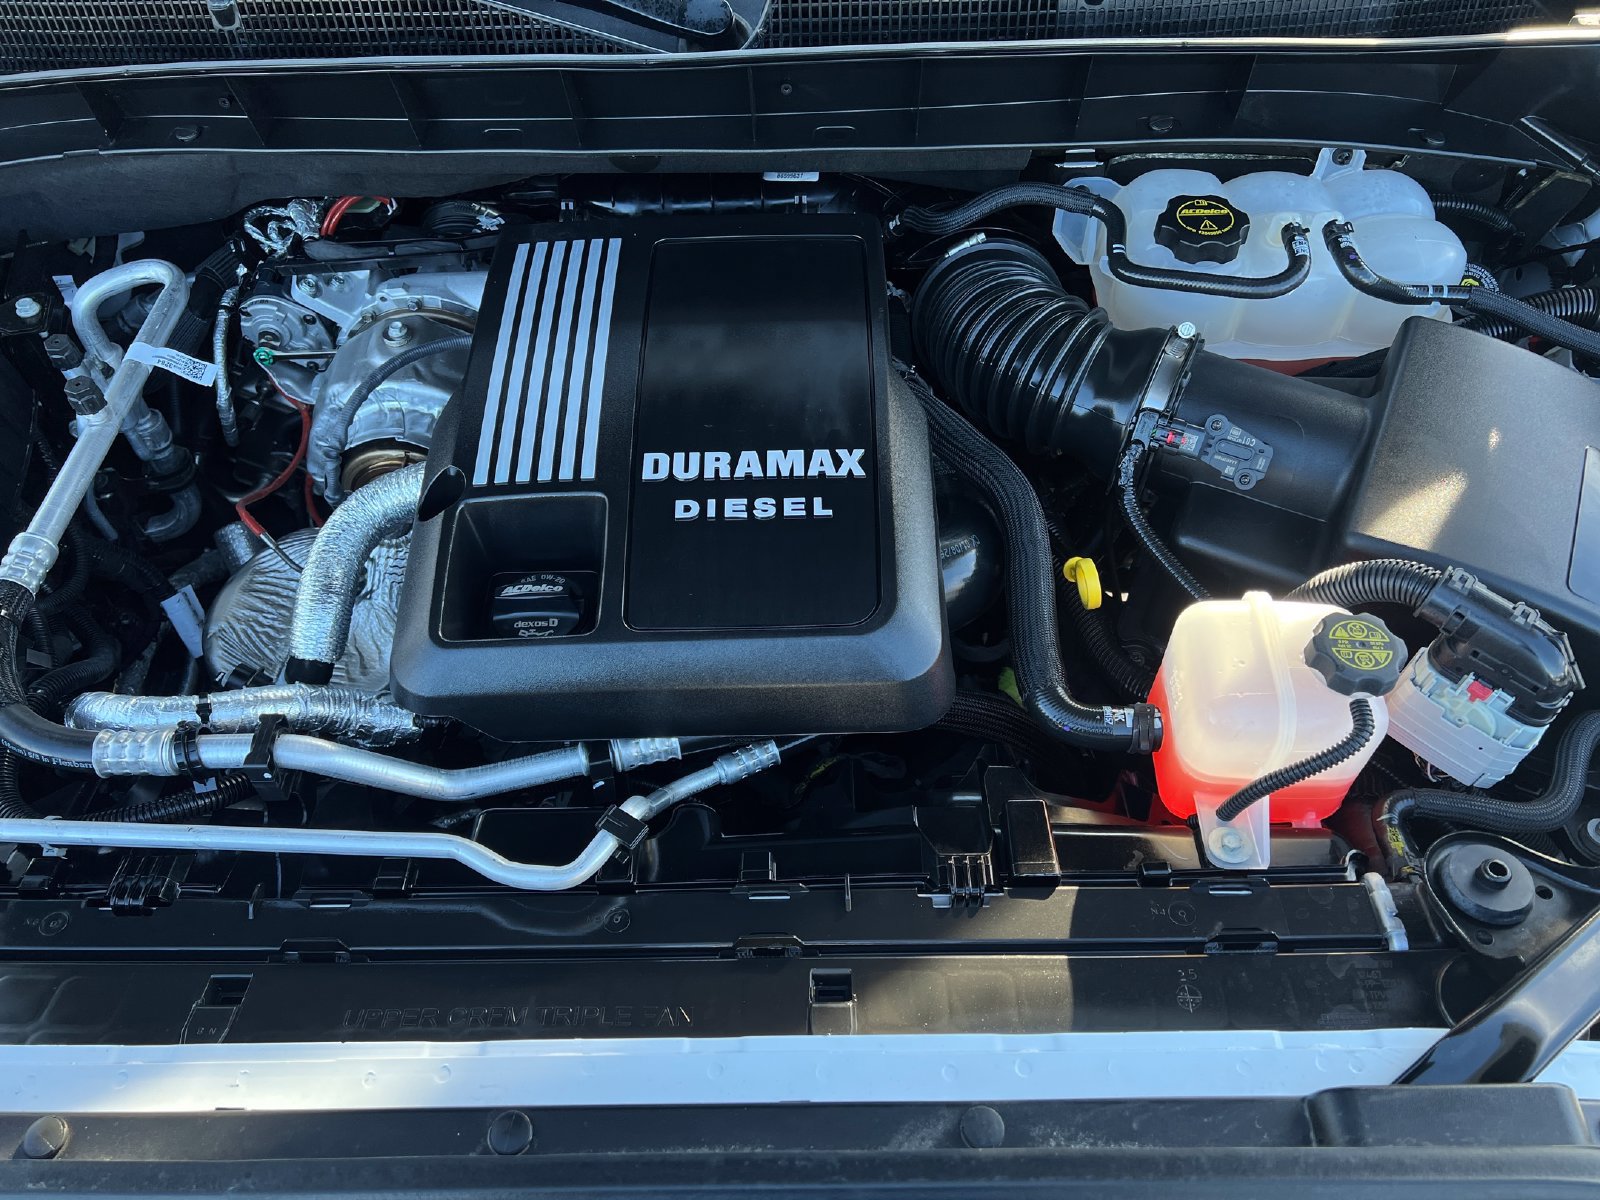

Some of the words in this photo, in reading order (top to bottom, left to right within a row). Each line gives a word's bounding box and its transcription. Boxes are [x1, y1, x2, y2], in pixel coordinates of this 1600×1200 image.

[641, 448, 867, 482] DURAMAX
[674, 496, 834, 521] DIESEL
[501, 584, 564, 594] ACDelco
[540, 574, 566, 584] 0W-20
[342, 1007, 441, 1029] UPPER
[535, 1006, 633, 1026] TRIPLE
[641, 1006, 695, 1027] FAN
